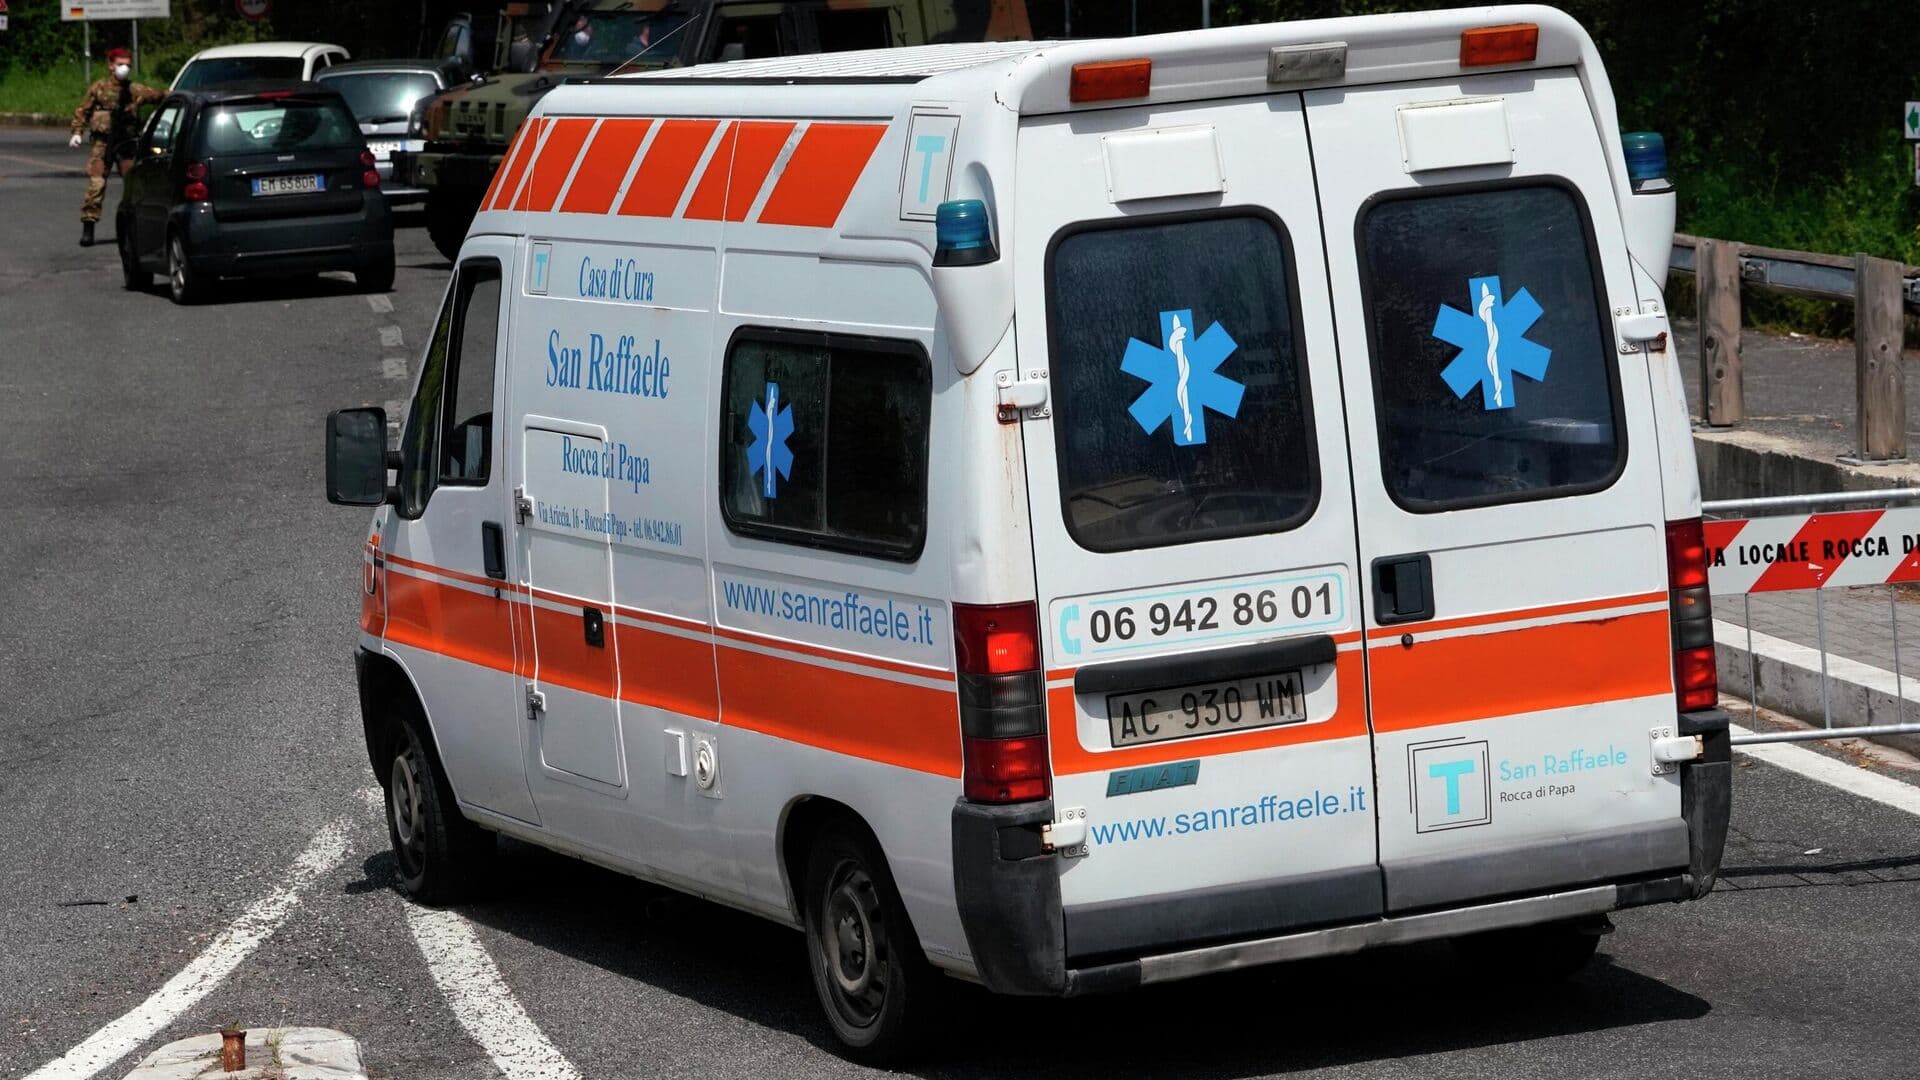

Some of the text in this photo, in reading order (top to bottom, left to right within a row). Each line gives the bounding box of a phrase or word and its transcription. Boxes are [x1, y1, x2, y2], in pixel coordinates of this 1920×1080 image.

[261, 178, 276, 191] EM
[579, 256, 654, 301] Casa di Cura
[546, 329, 670, 399] San Raffaele
[562, 435, 650, 494] Rocca di Papa
[537, 501, 548, 523] Via
[584, 509, 602, 532] Rocca
[603, 513, 610, 535] di
[611, 513, 627, 542] Papa
[1739, 541, 1810, 565] LOCALE
[1823, 536, 1889, 560] ROCCA
[723, 580, 934, 646] www.sanraffaele.it
[1089, 582, 1332, 643] 06 942 86 01
[1121, 678, 1297, 739] AC 930 WM
[1114, 765, 1195, 794] FIAT
[1499, 744, 1628, 782] San Raffaele
[1091, 785, 1366, 846] www.sanraffaele.it
[1500, 783, 1576, 803] Rocca di Papa
